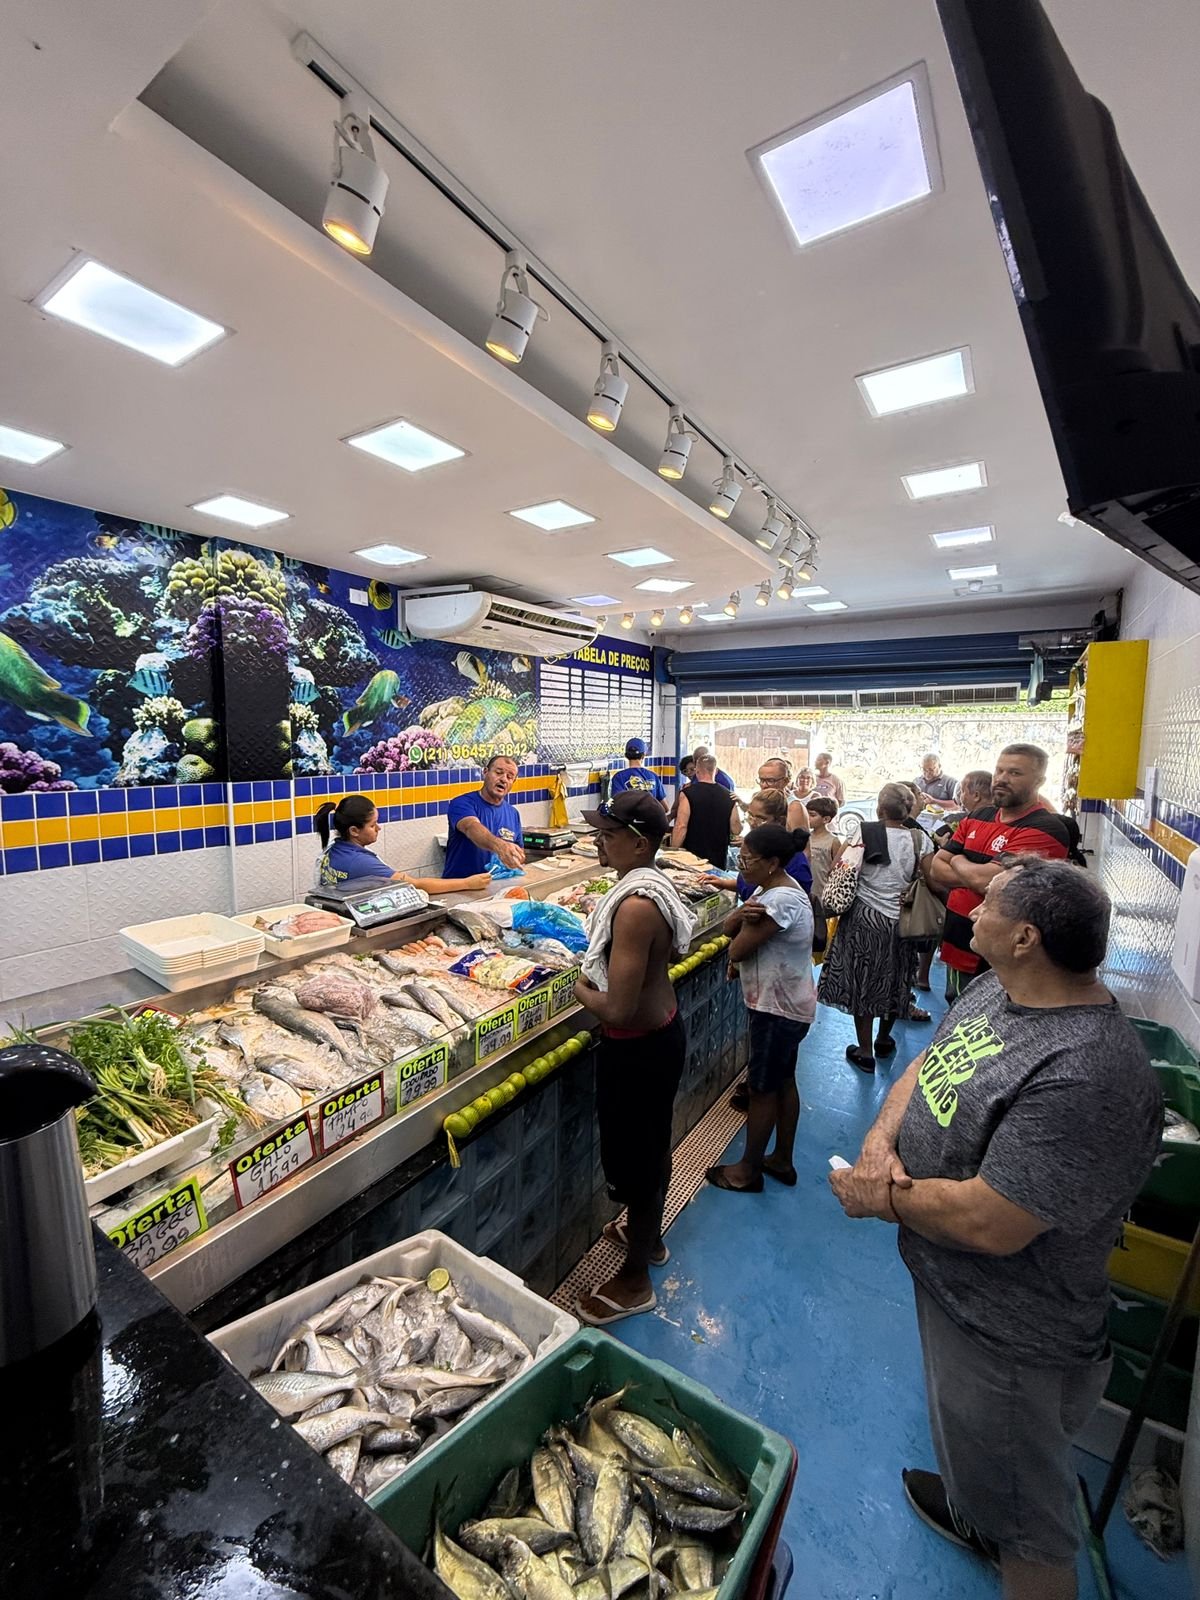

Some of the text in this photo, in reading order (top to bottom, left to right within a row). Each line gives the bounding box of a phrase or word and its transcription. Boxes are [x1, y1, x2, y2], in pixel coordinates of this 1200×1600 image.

[573, 646, 650, 673] TABELA DE PREÇOS
[423, 747, 448, 763] (21)
[553, 971, 578, 992] Oferta
[519, 992, 547, 1012] Oferta
[480, 1011, 513, 1035] Oferta
[957, 1013, 1004, 1055] JUST
[402, 1050, 444, 1079] Oferta
[936, 1032, 977, 1077] KEEP
[324, 1078, 380, 1116] Oferta
[236, 1120, 307, 1173] Oferta
[250, 1144, 292, 1182] GALO
[257, 1153, 299, 1196] 15.99
